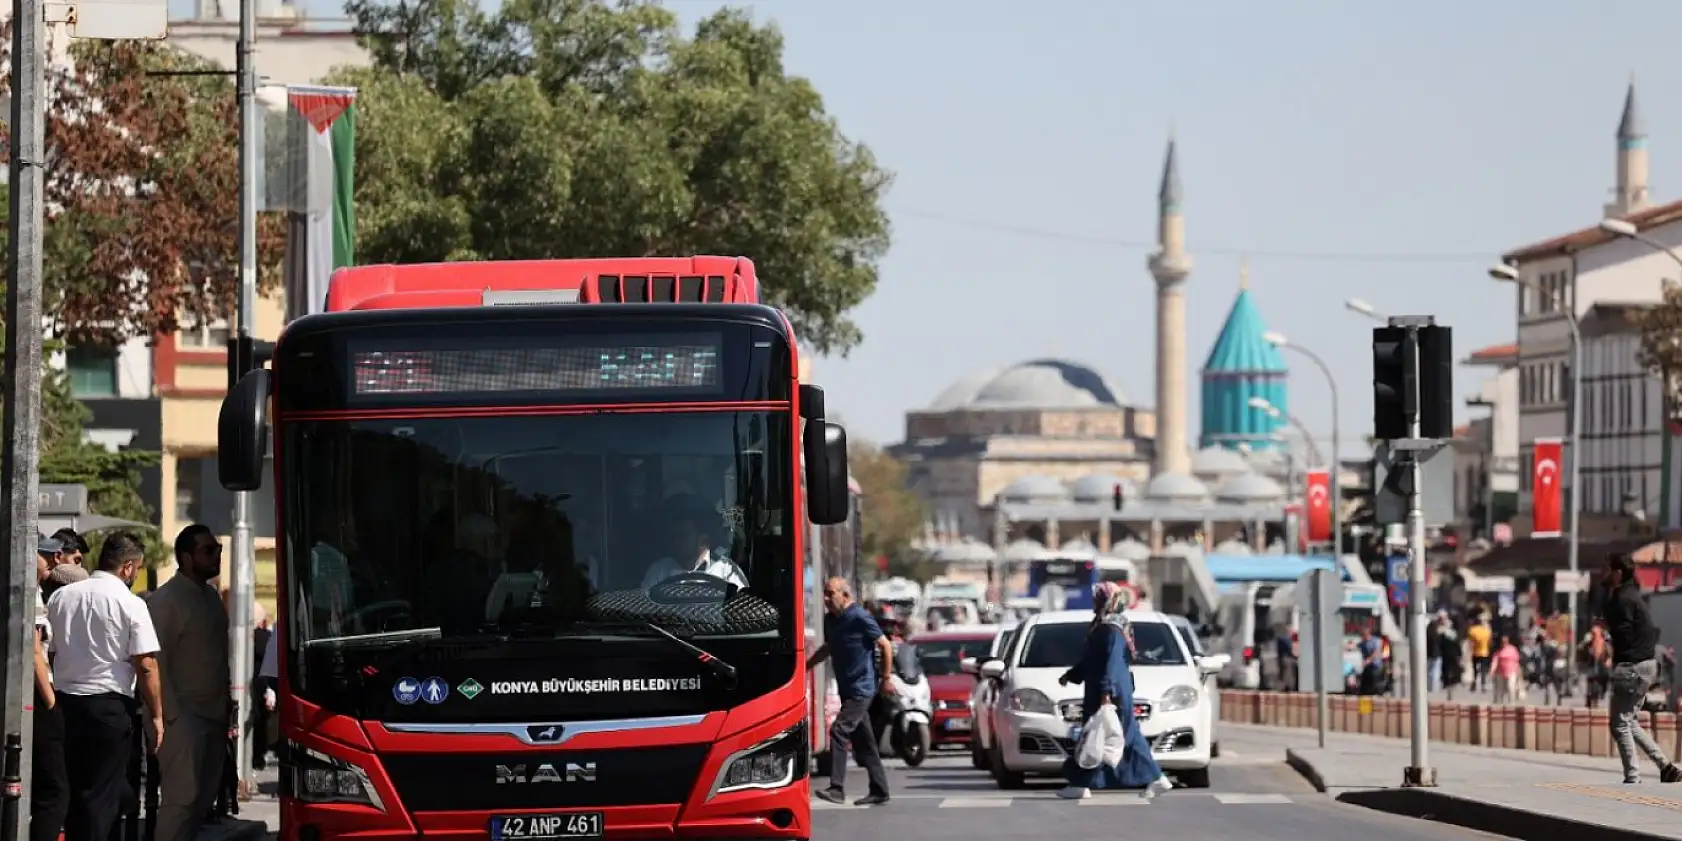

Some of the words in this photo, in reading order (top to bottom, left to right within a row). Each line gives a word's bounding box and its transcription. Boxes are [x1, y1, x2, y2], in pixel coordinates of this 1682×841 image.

[491, 681, 539, 694] KONYA
[542, 677, 620, 695] BÜYÜKŞEHİR
[622, 674, 701, 692] BELEDİYESİ
[496, 762, 597, 784] MAN
[502, 818, 525, 836] 42
[529, 817, 561, 836] ANP
[567, 815, 598, 834] 461
